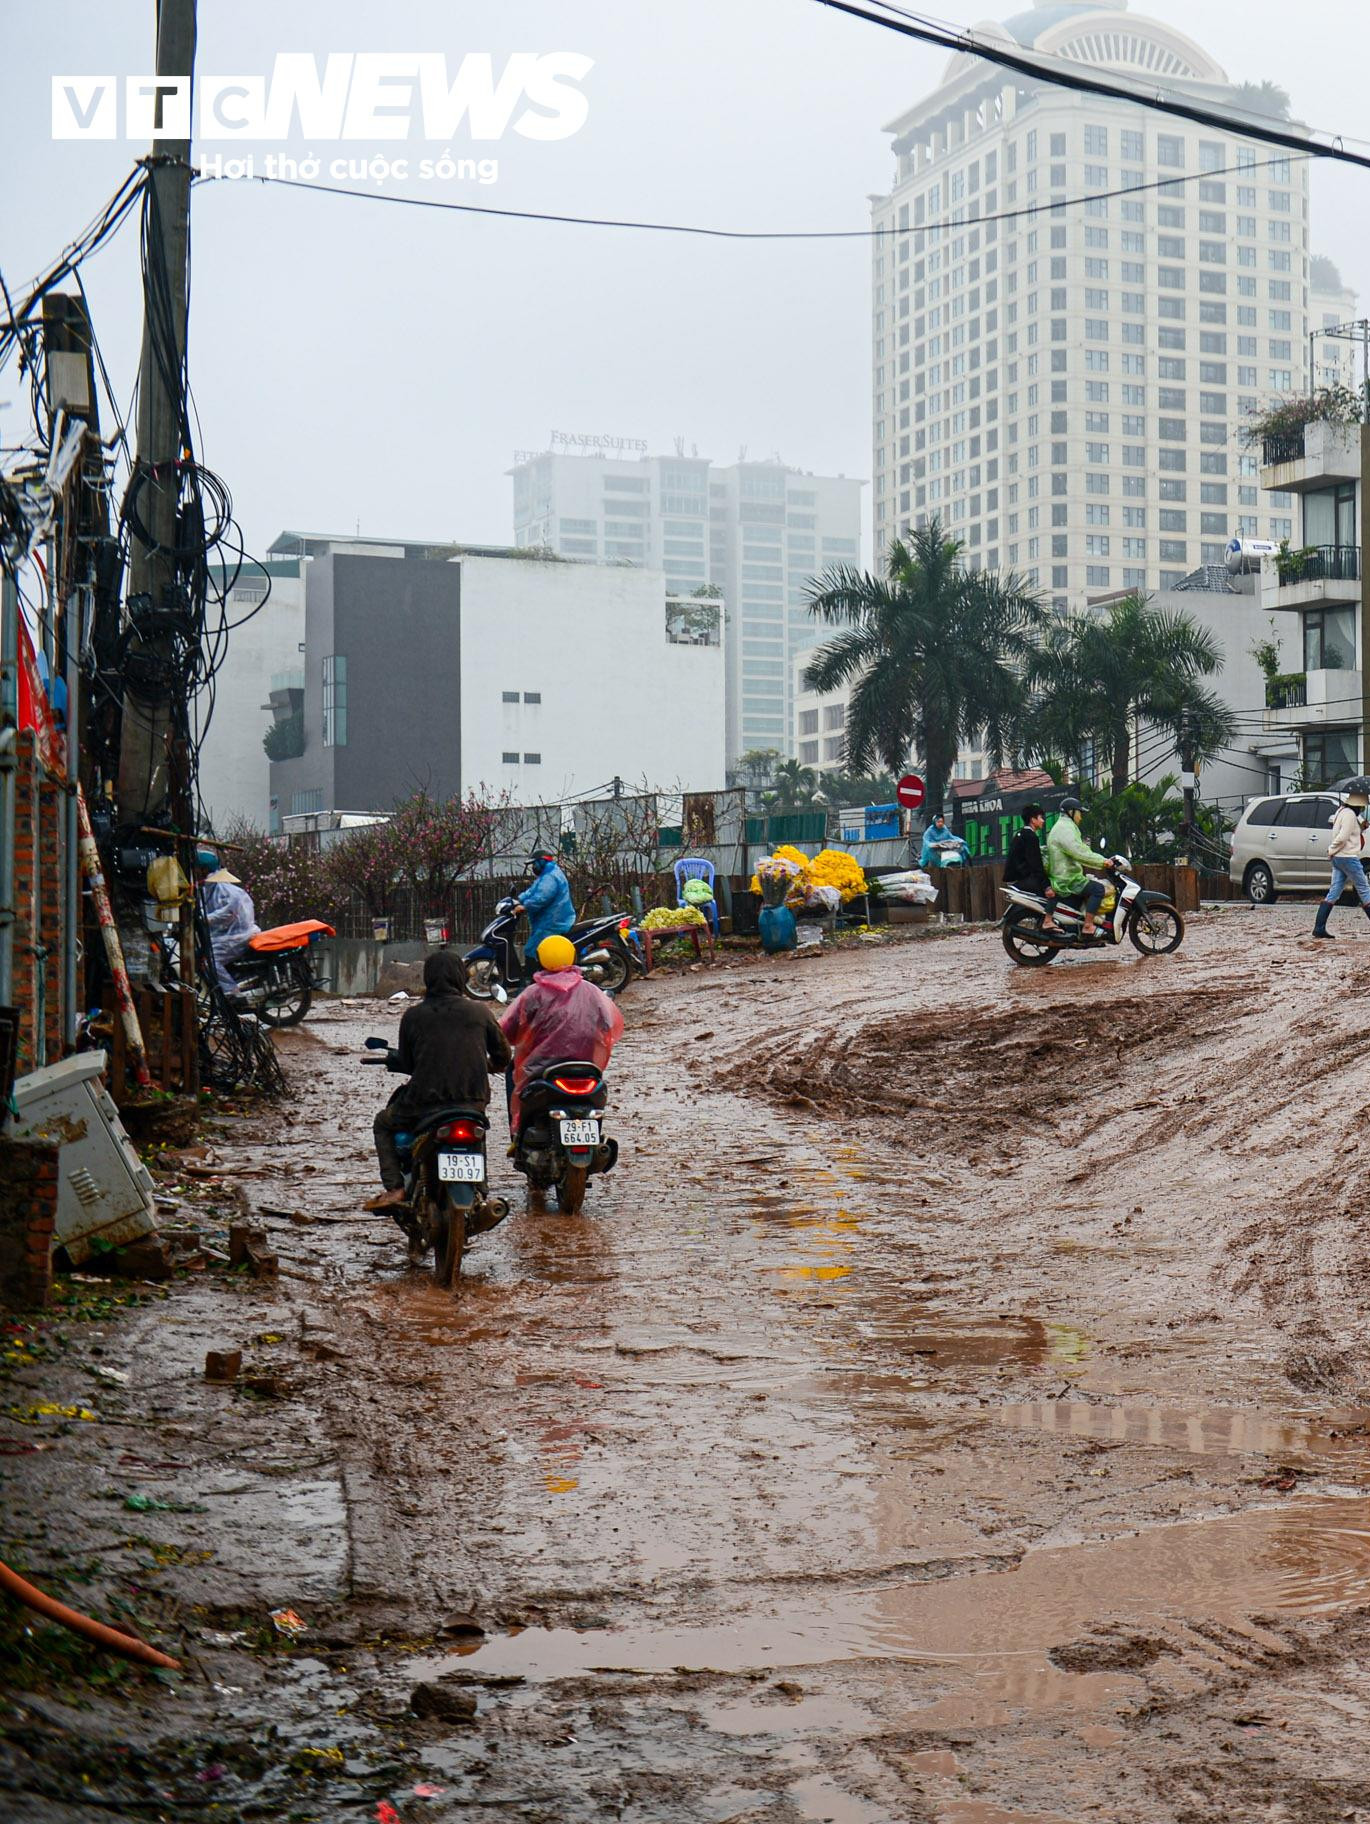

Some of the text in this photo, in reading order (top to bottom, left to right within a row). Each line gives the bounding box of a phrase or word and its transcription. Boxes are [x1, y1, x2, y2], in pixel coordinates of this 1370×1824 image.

[566, 1122, 592, 1133] 29-F1
[564, 1133, 597, 1143] 664.05
[446, 1156, 477, 1166] 19-S1
[442, 1168, 481, 1179] 330.97
